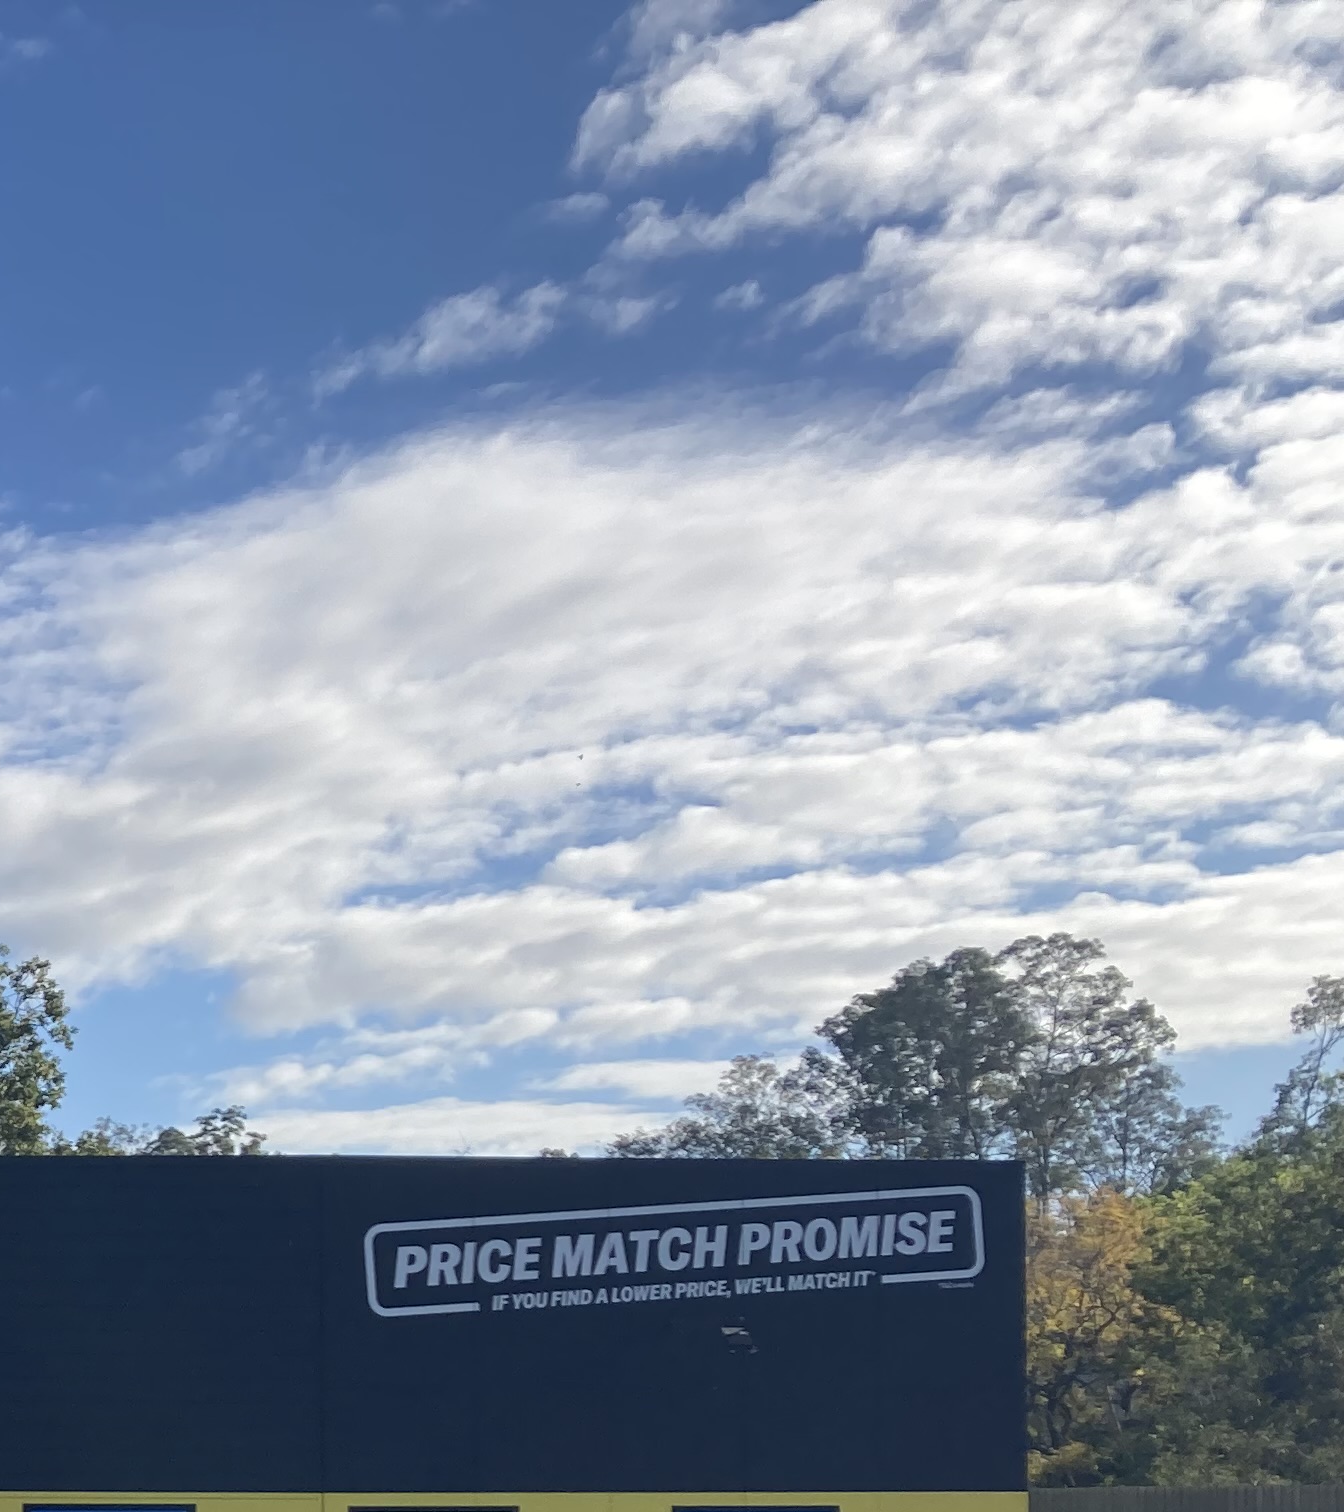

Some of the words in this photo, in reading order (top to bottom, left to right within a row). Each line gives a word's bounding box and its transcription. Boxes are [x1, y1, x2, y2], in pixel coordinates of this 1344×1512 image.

[393, 1237, 542, 1288] PRICE
[551, 1224, 728, 1278] MATCH
[737, 1210, 956, 1265] PROMISE
[491, 1294, 509, 1311] IF
[511, 1292, 547, 1310] YOU
[550, 1289, 593, 1307] FIND
[595, 1288, 608, 1304] A
[610, 1283, 673, 1303] LOWER
[674, 1280, 731, 1299] PRICE,
[735, 1276, 785, 1295] WE'LL
[788, 1272, 852, 1292] MATCH
